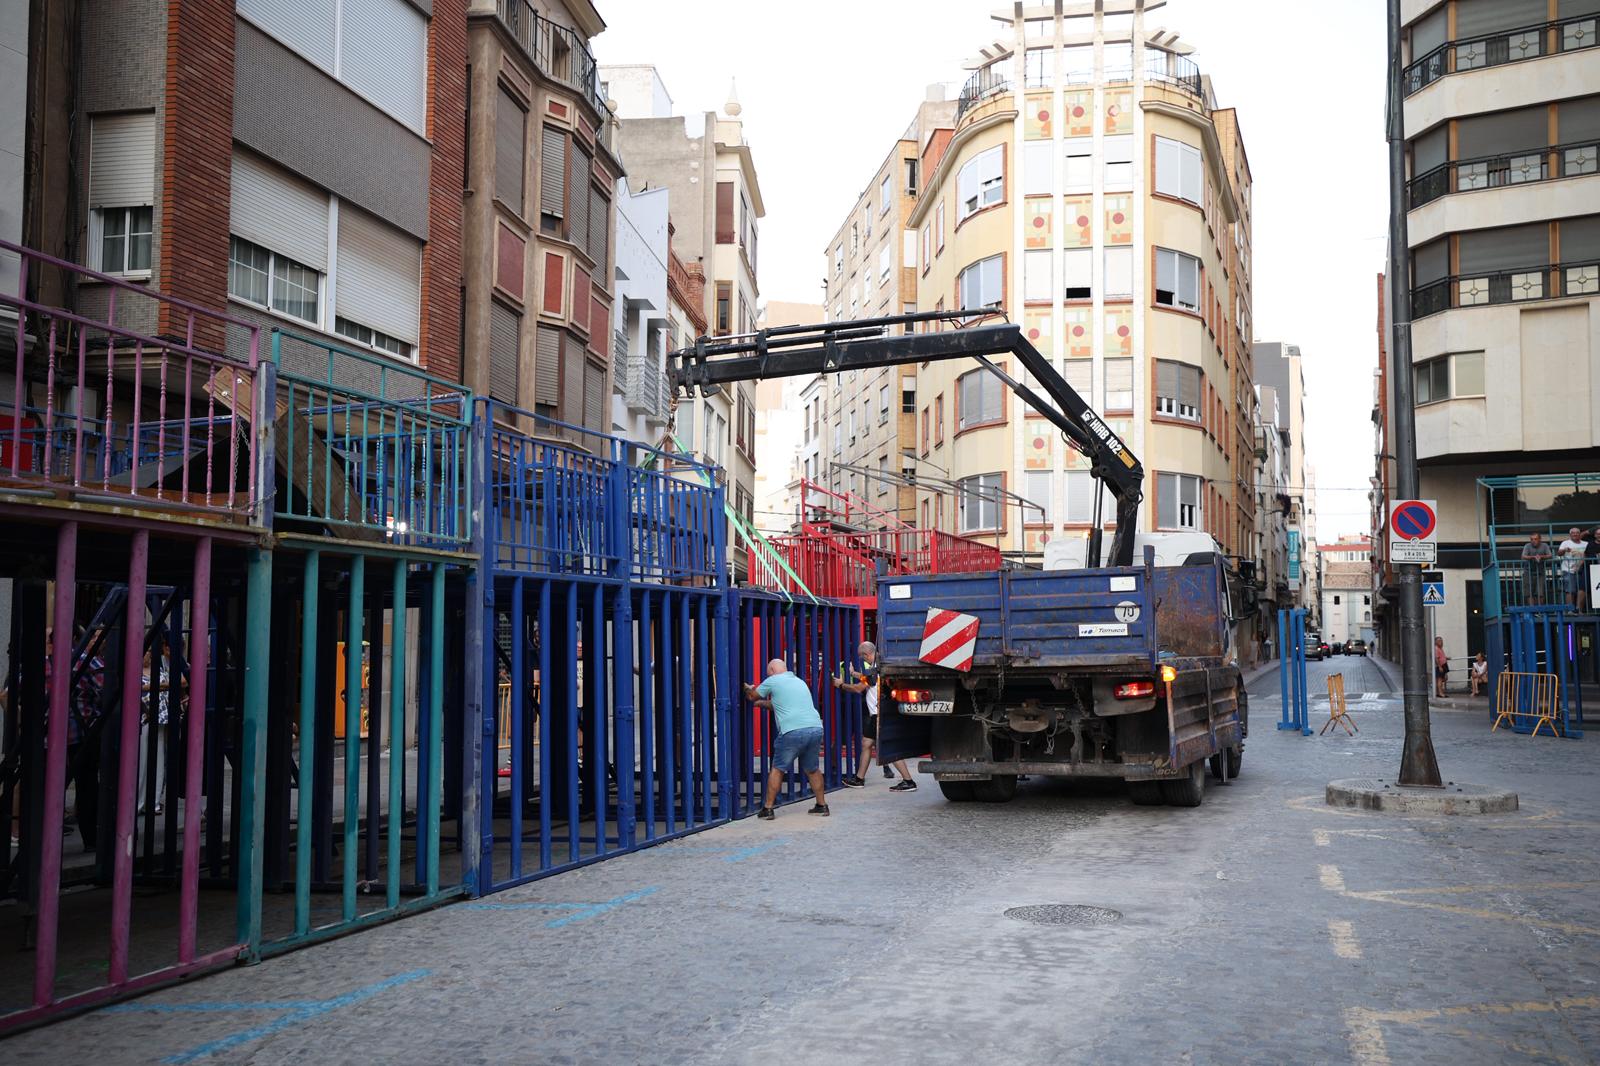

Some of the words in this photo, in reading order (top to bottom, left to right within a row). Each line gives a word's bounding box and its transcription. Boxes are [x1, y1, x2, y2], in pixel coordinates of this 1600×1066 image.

[1090, 419, 1110, 440] HIAB
[1106, 436, 1122, 455] 102
[1122, 606, 1135, 617] 70
[907, 702, 929, 712] 3317
[933, 702, 951, 712] FZX
